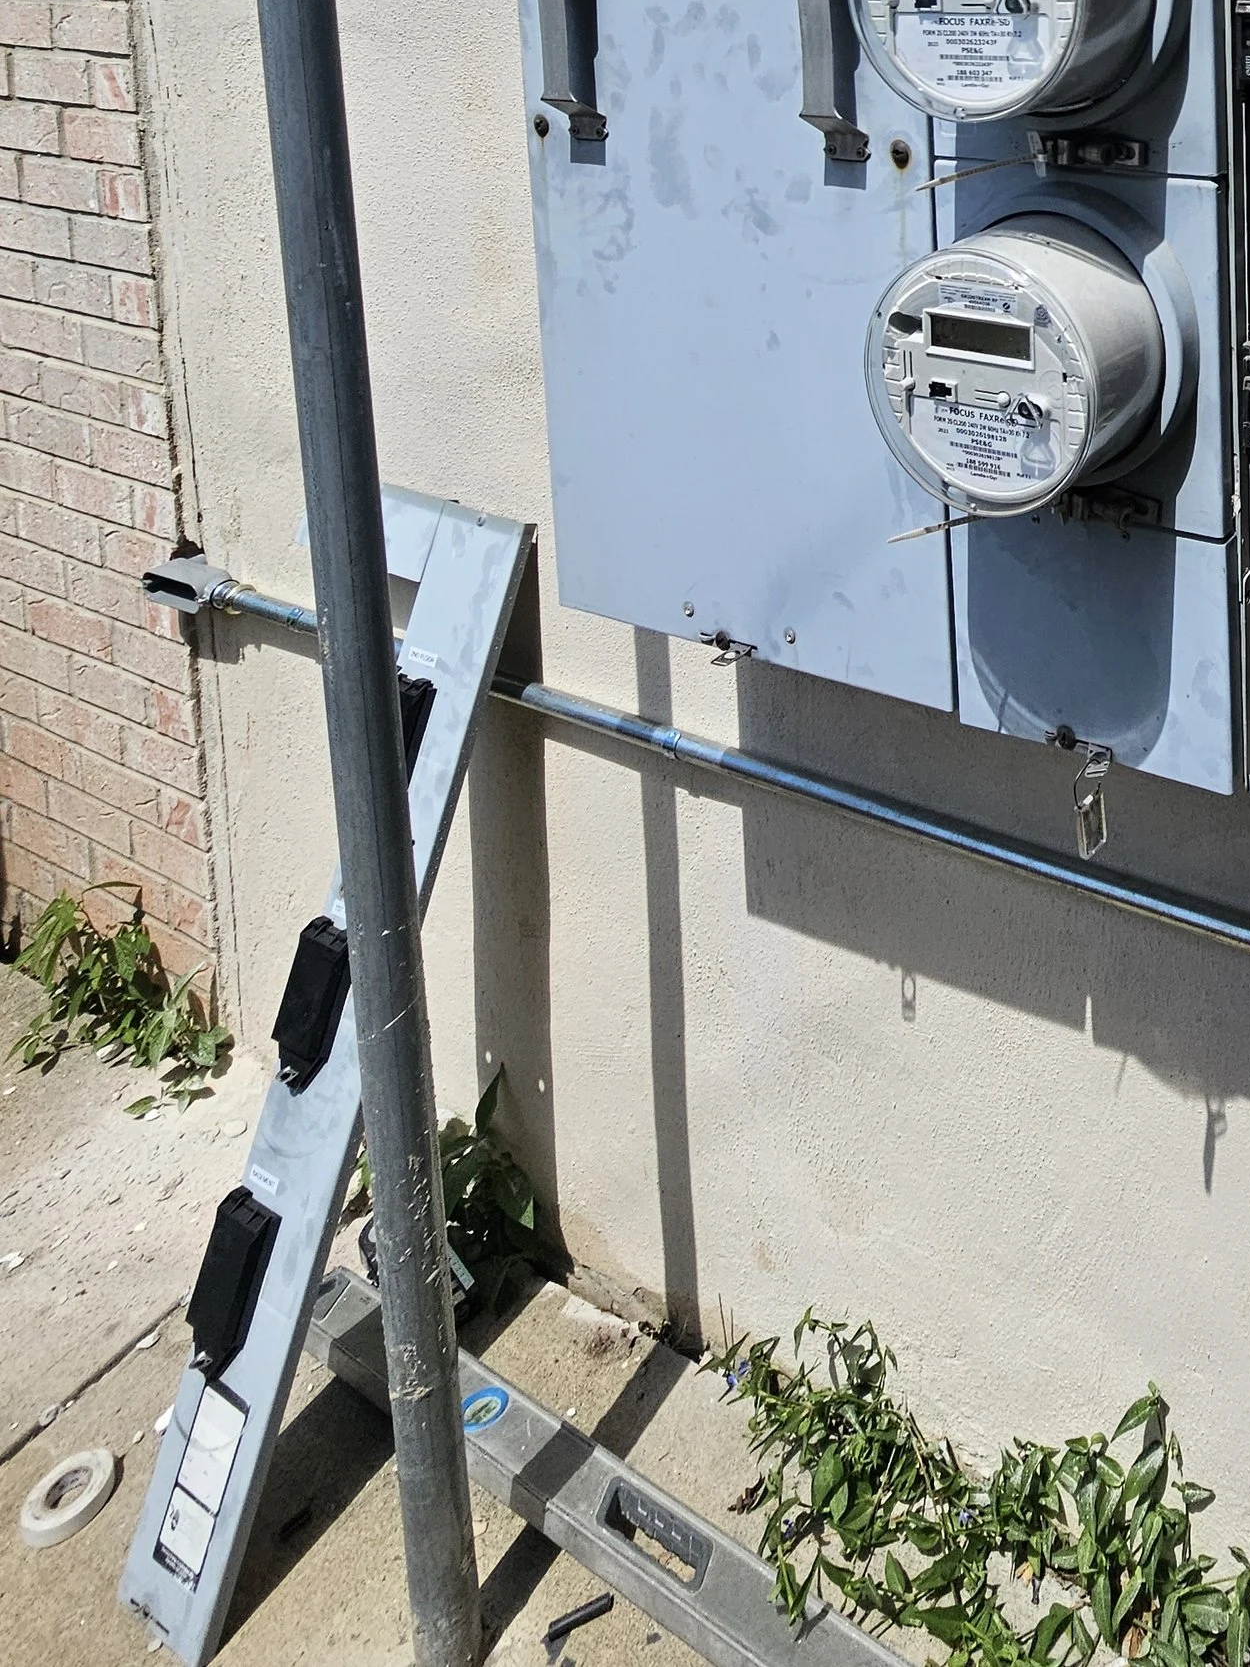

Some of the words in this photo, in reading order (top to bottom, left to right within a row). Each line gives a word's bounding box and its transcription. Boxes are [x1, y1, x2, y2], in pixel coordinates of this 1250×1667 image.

[940, 18, 966, 26] FOCUS
[950, 407, 976, 419] FOCUS
[971, 438, 993, 448] PSE&G
